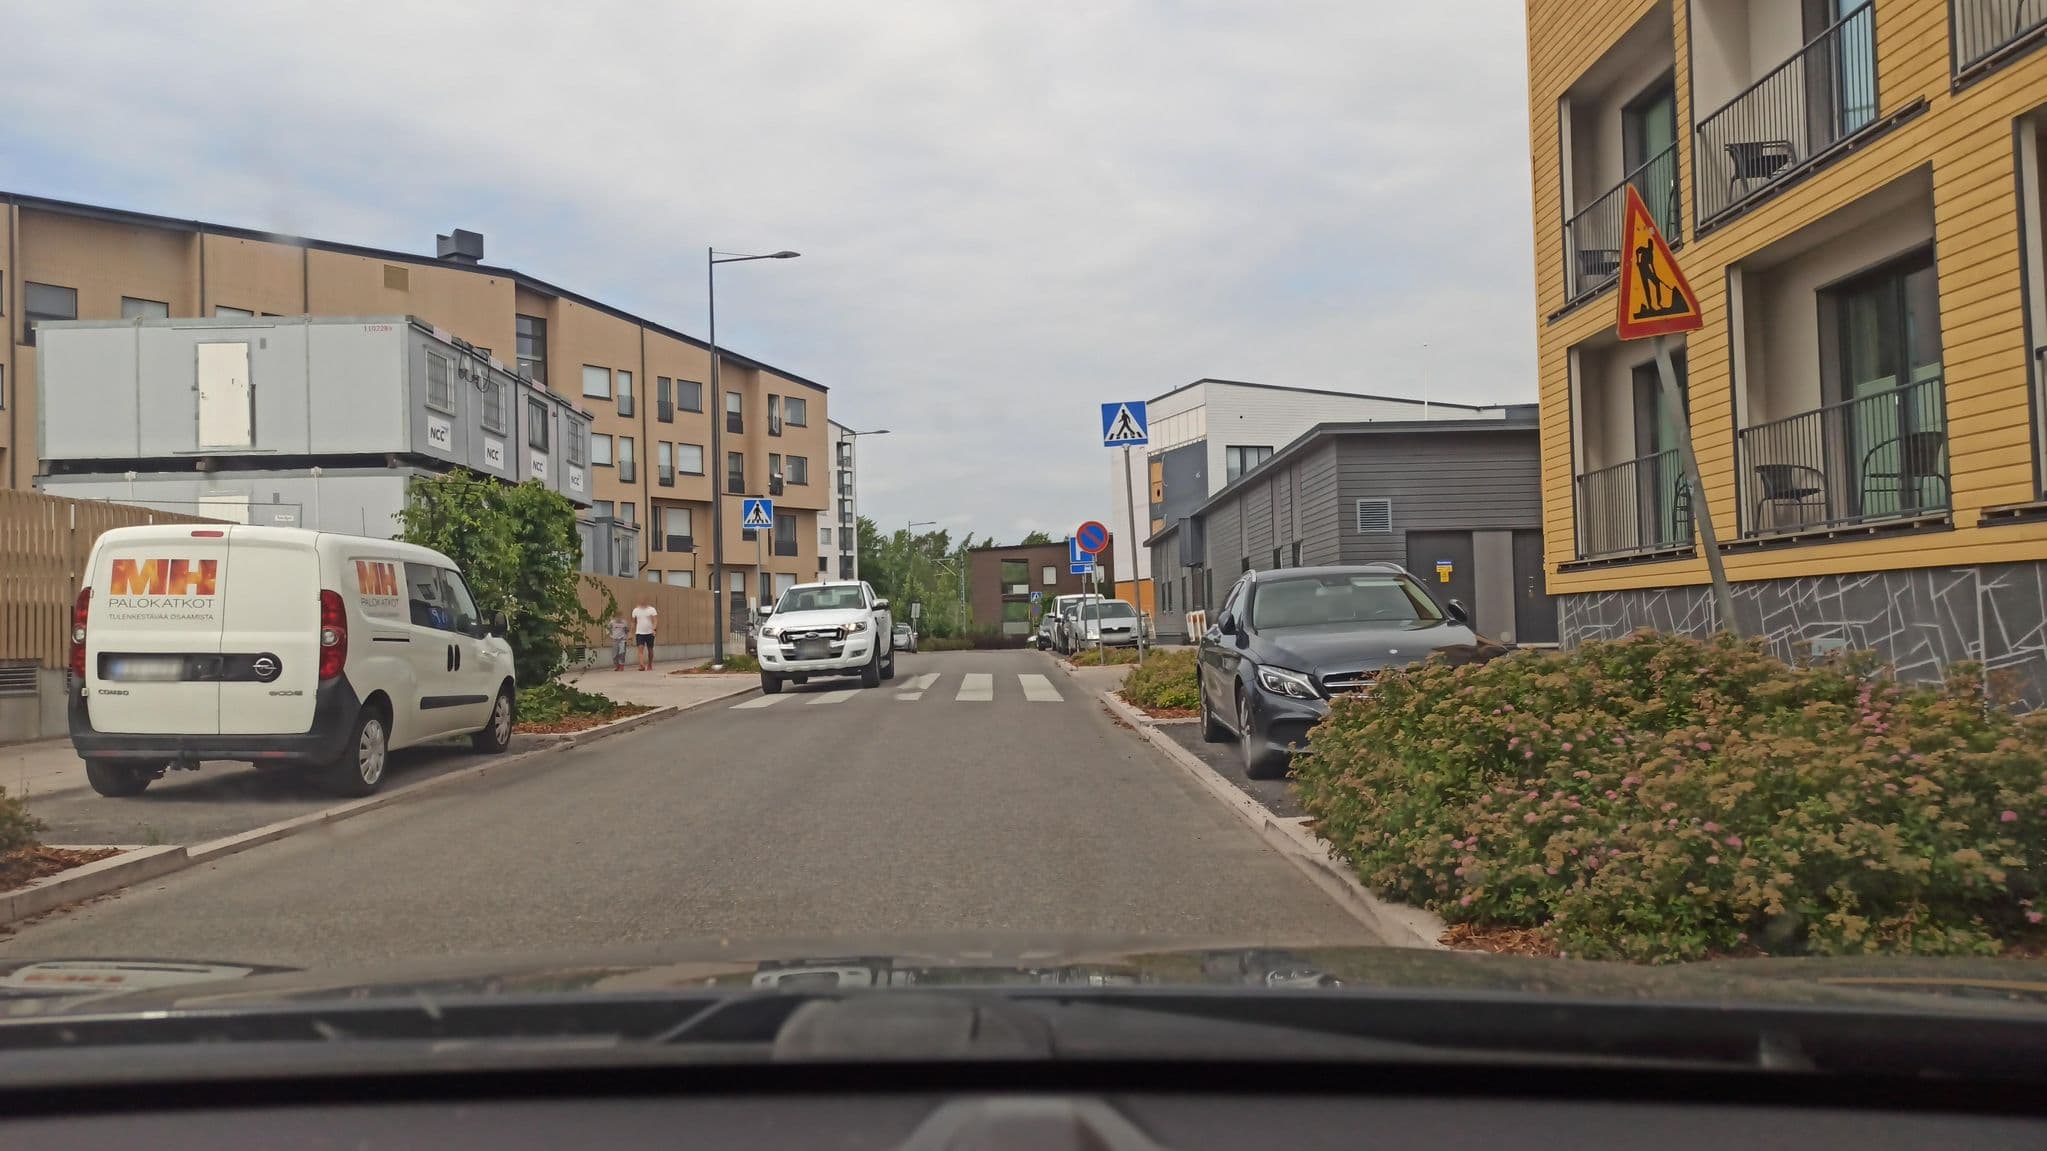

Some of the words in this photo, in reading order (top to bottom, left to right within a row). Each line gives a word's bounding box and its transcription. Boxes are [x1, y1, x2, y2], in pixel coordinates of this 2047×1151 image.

[430, 426, 445, 442] NCC
[486, 447, 499, 461] NCC
[532, 460, 544, 473] NCC
[110, 559, 218, 595] MH
[355, 561, 398, 596] MH
[108, 598, 214, 609] PALOKATKOT
